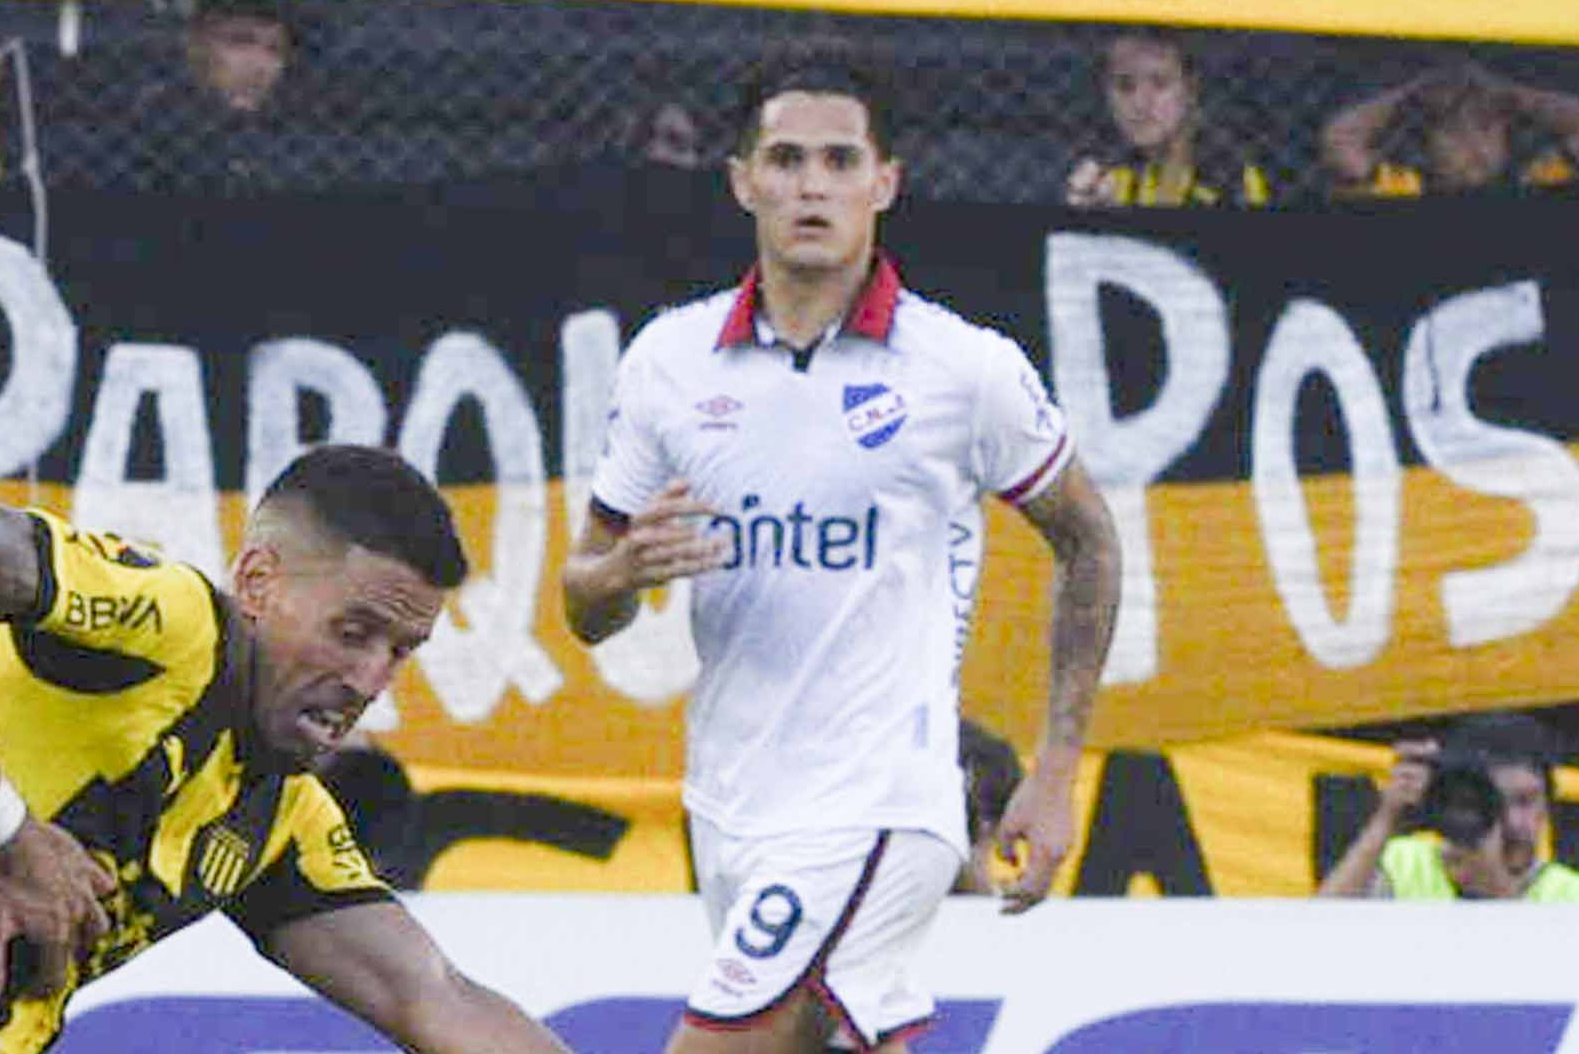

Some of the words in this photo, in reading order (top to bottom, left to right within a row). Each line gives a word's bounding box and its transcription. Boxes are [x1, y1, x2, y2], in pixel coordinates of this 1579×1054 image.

[708, 493, 878, 571] antel
[65, 589, 163, 635] BBVA
[734, 882, 803, 959] 9
